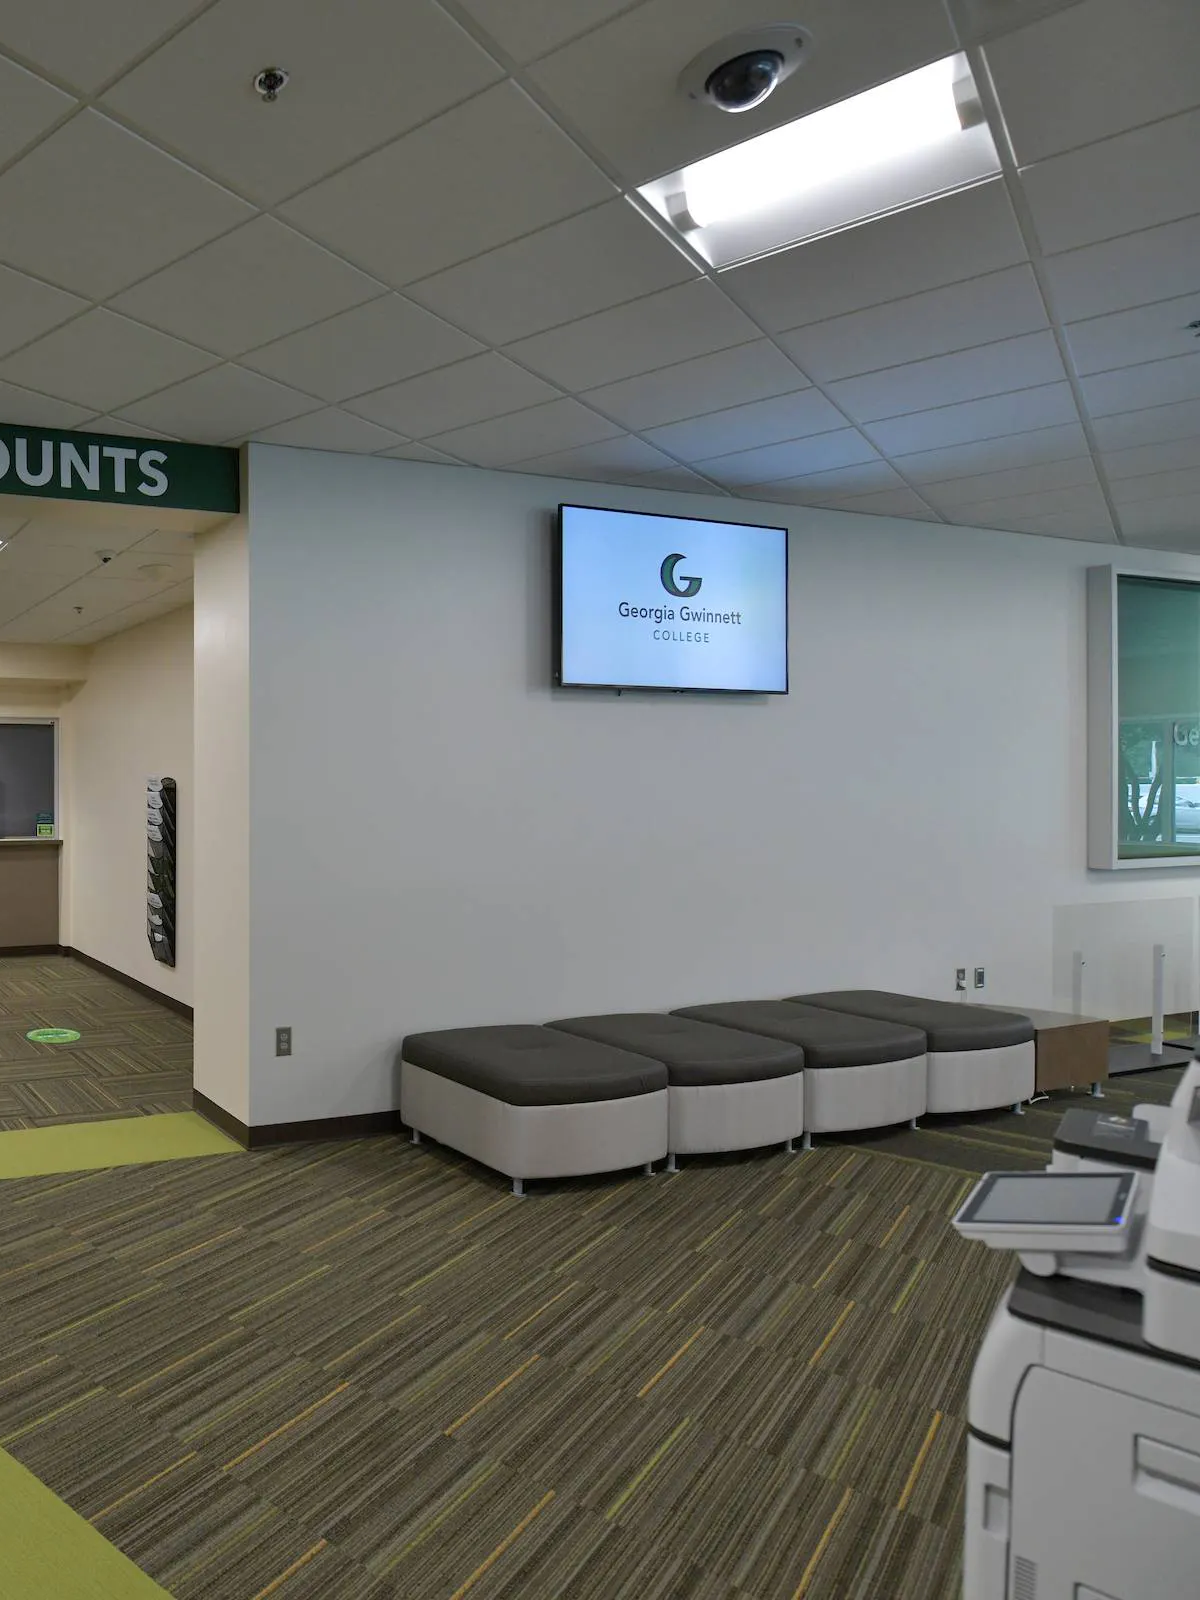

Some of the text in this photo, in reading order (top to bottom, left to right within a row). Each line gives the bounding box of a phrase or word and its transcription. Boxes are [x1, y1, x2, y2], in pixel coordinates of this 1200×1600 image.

[618, 601, 742, 625] Georgia Gwinnett
[652, 628, 711, 643] COLLEGE
